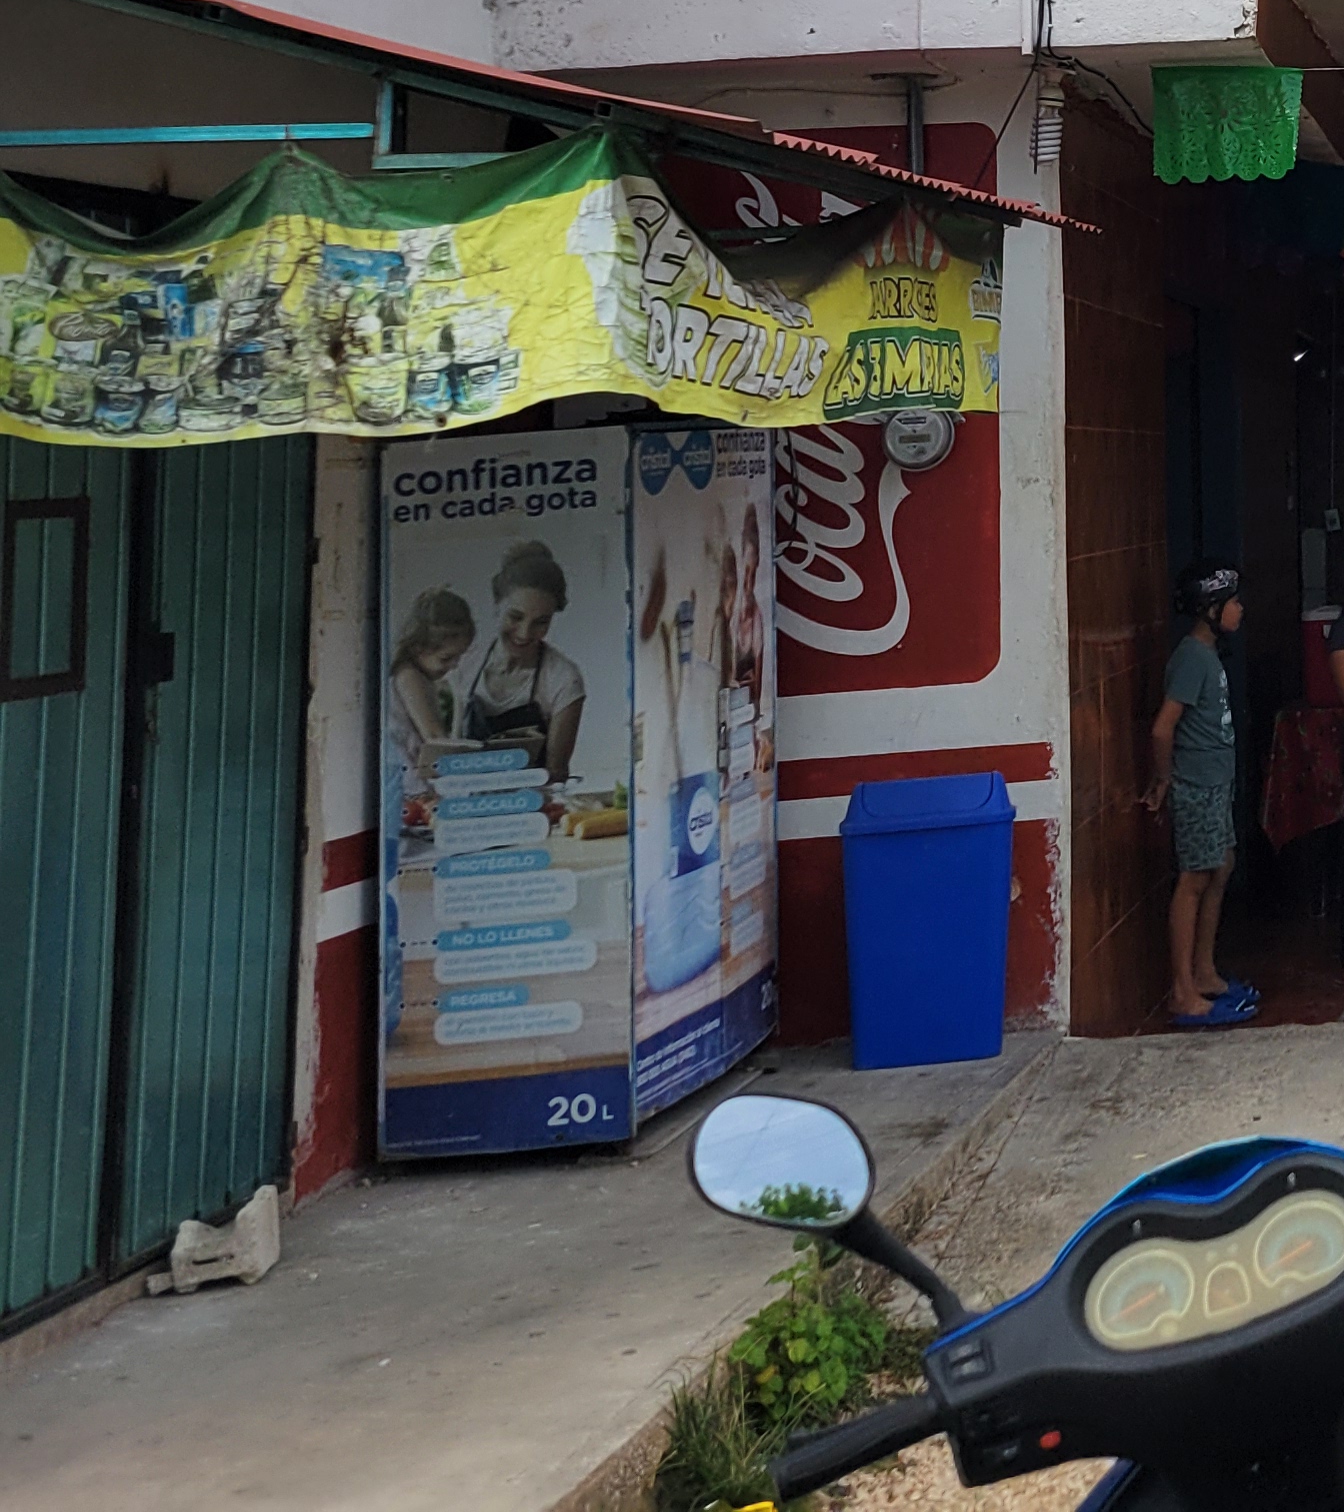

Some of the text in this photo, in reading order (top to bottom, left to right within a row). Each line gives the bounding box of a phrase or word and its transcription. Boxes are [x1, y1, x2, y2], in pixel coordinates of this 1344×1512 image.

[393, 456, 597, 497] confianza
[393, 487, 598, 523] en cada gota
[452, 933, 475, 947] NO
[477, 931, 497, 944] LO
[547, 1093, 614, 1126] 20 L
